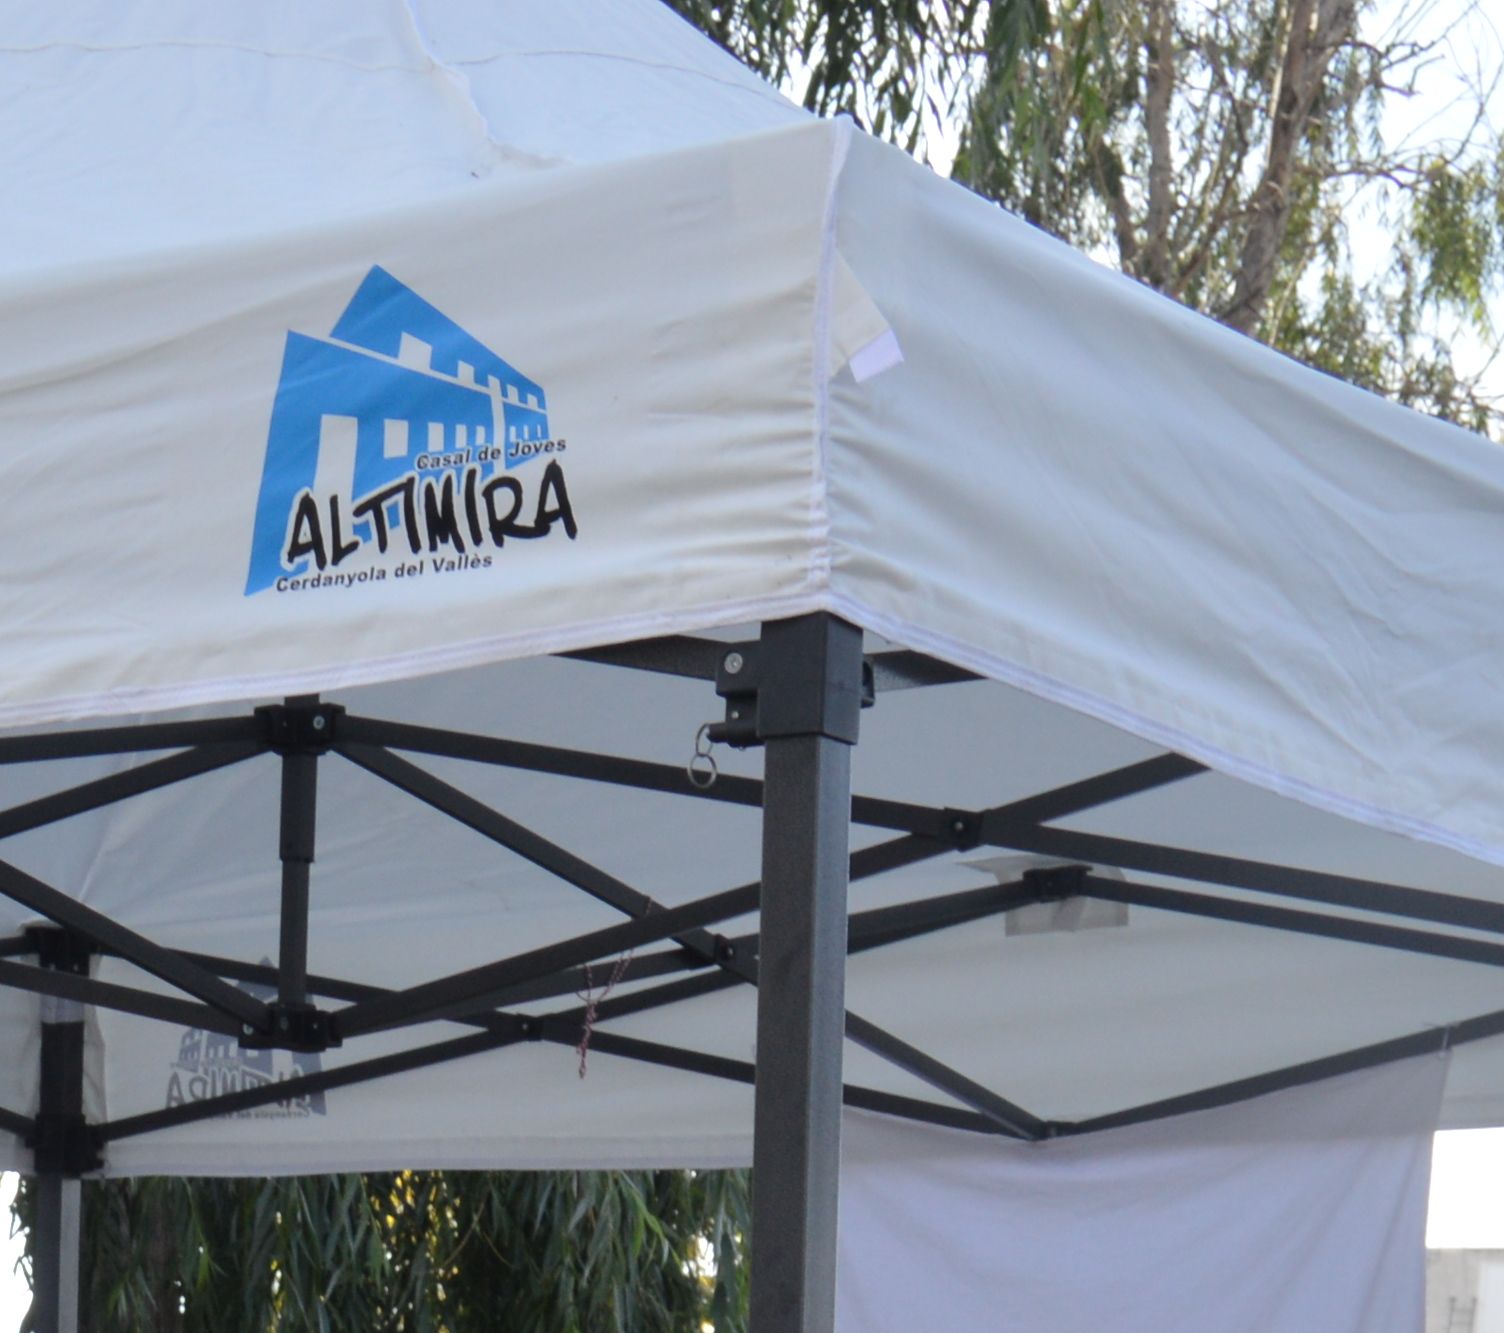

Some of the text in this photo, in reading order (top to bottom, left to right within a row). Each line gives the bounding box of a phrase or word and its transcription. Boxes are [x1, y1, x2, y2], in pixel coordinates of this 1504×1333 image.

[416, 435, 568, 471] Casal de Joves
[287, 459, 578, 571] ALTIMIRA
[275, 552, 494, 593] Cerdanyola del Vallès
